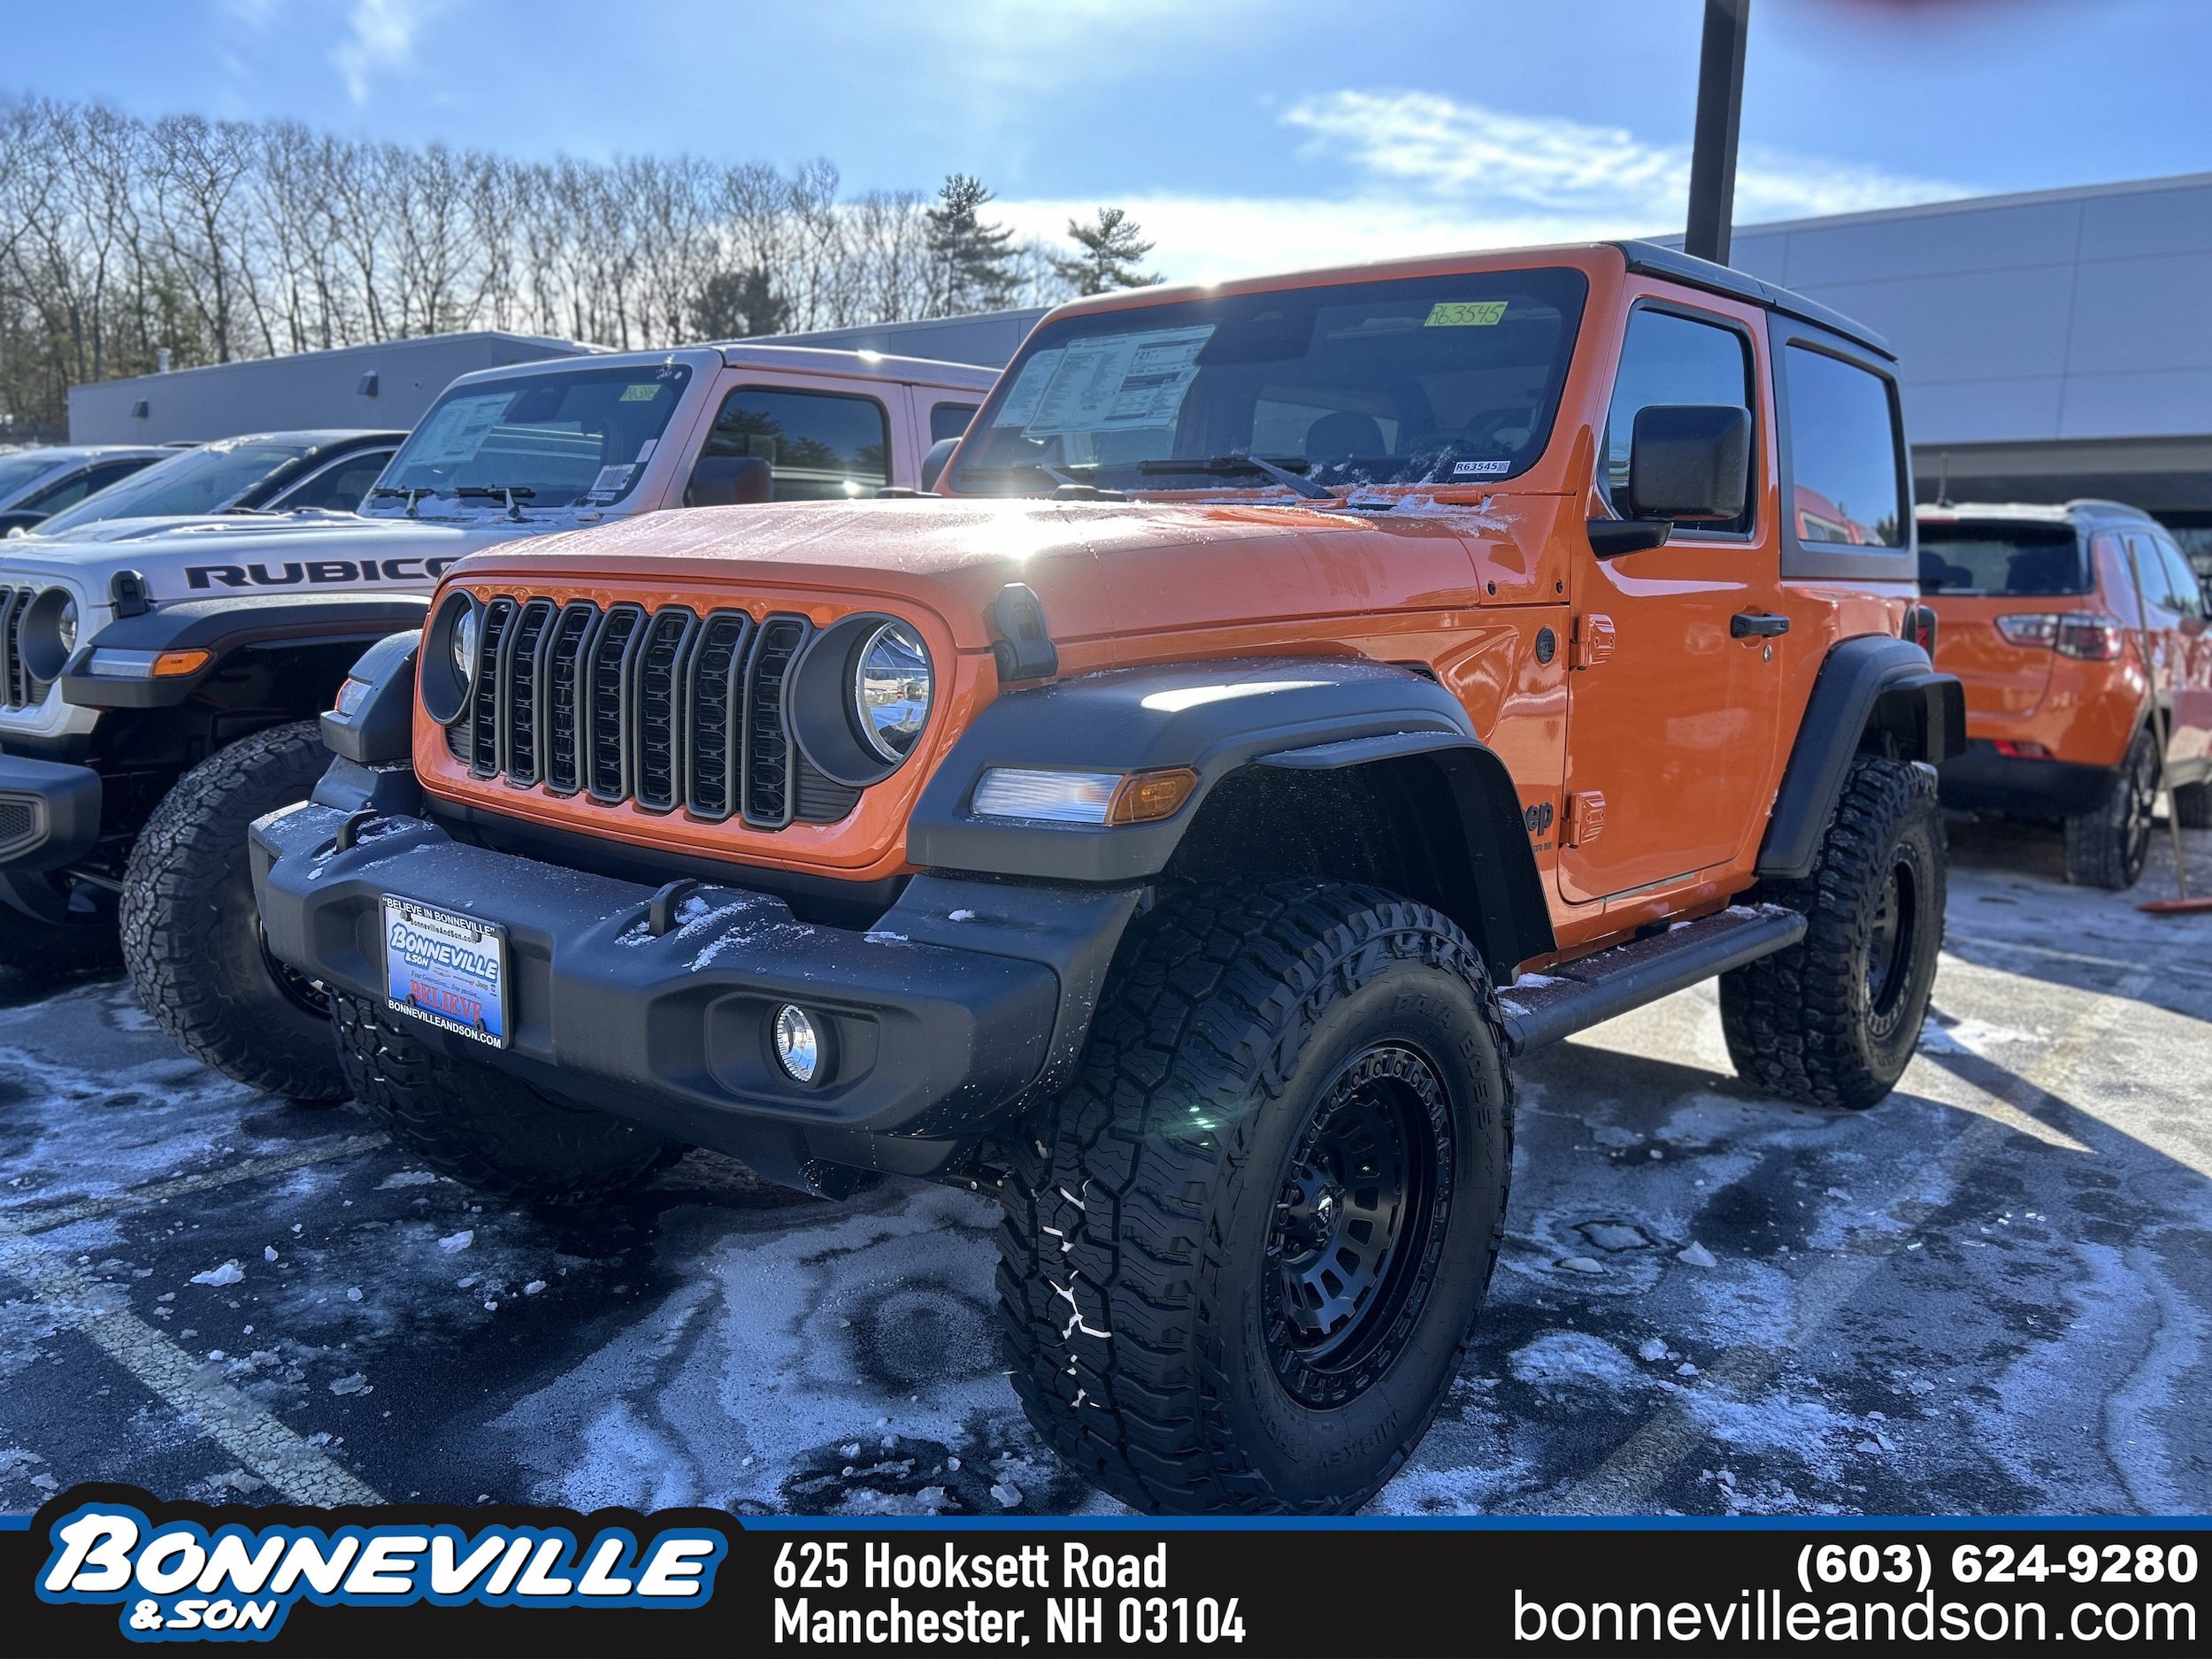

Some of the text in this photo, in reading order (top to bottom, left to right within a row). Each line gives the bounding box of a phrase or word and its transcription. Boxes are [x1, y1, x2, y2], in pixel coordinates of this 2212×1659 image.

[1426, 304, 1506, 325] R63545
[184, 557, 464, 590] RUBICO
[1526, 803, 1554, 836] ep
[423, 908, 434, 919] IN
[391, 925, 498, 980] BONNEVILLE
[410, 979, 482, 1022] BELIEVE
[388, 999, 502, 1048] BONNEVILLEANDSON.COM
